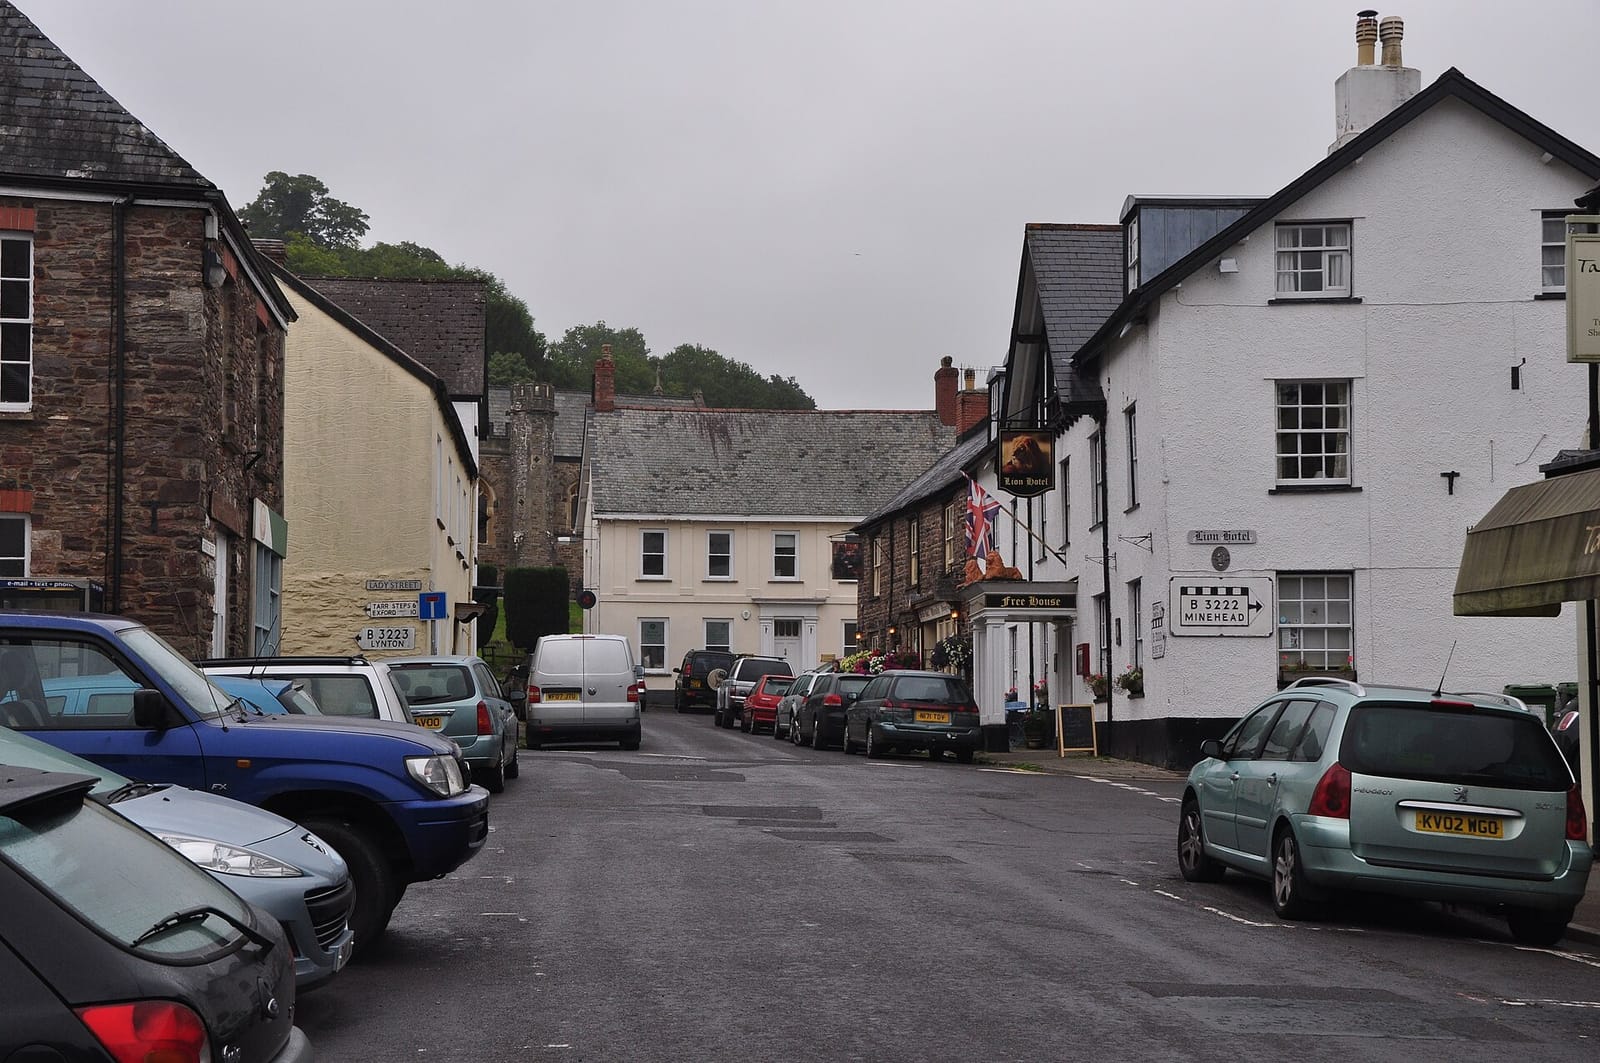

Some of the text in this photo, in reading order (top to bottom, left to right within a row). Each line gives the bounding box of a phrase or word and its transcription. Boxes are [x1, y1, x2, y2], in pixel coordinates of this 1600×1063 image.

[1004, 477, 1049, 486] Lion Hotel
[1195, 530, 1250, 543] Lion Hotel
[369, 581, 418, 589] LADY STREET
[1001, 596, 1061, 608] Free House
[1190, 600, 1239, 610] B 3222
[1185, 613, 1245, 621] MINEHEAD
[367, 629, 409, 640] B 3223
[370, 640, 405, 648] LYNTON
[1422, 815, 1498, 835] KV02 WGO
